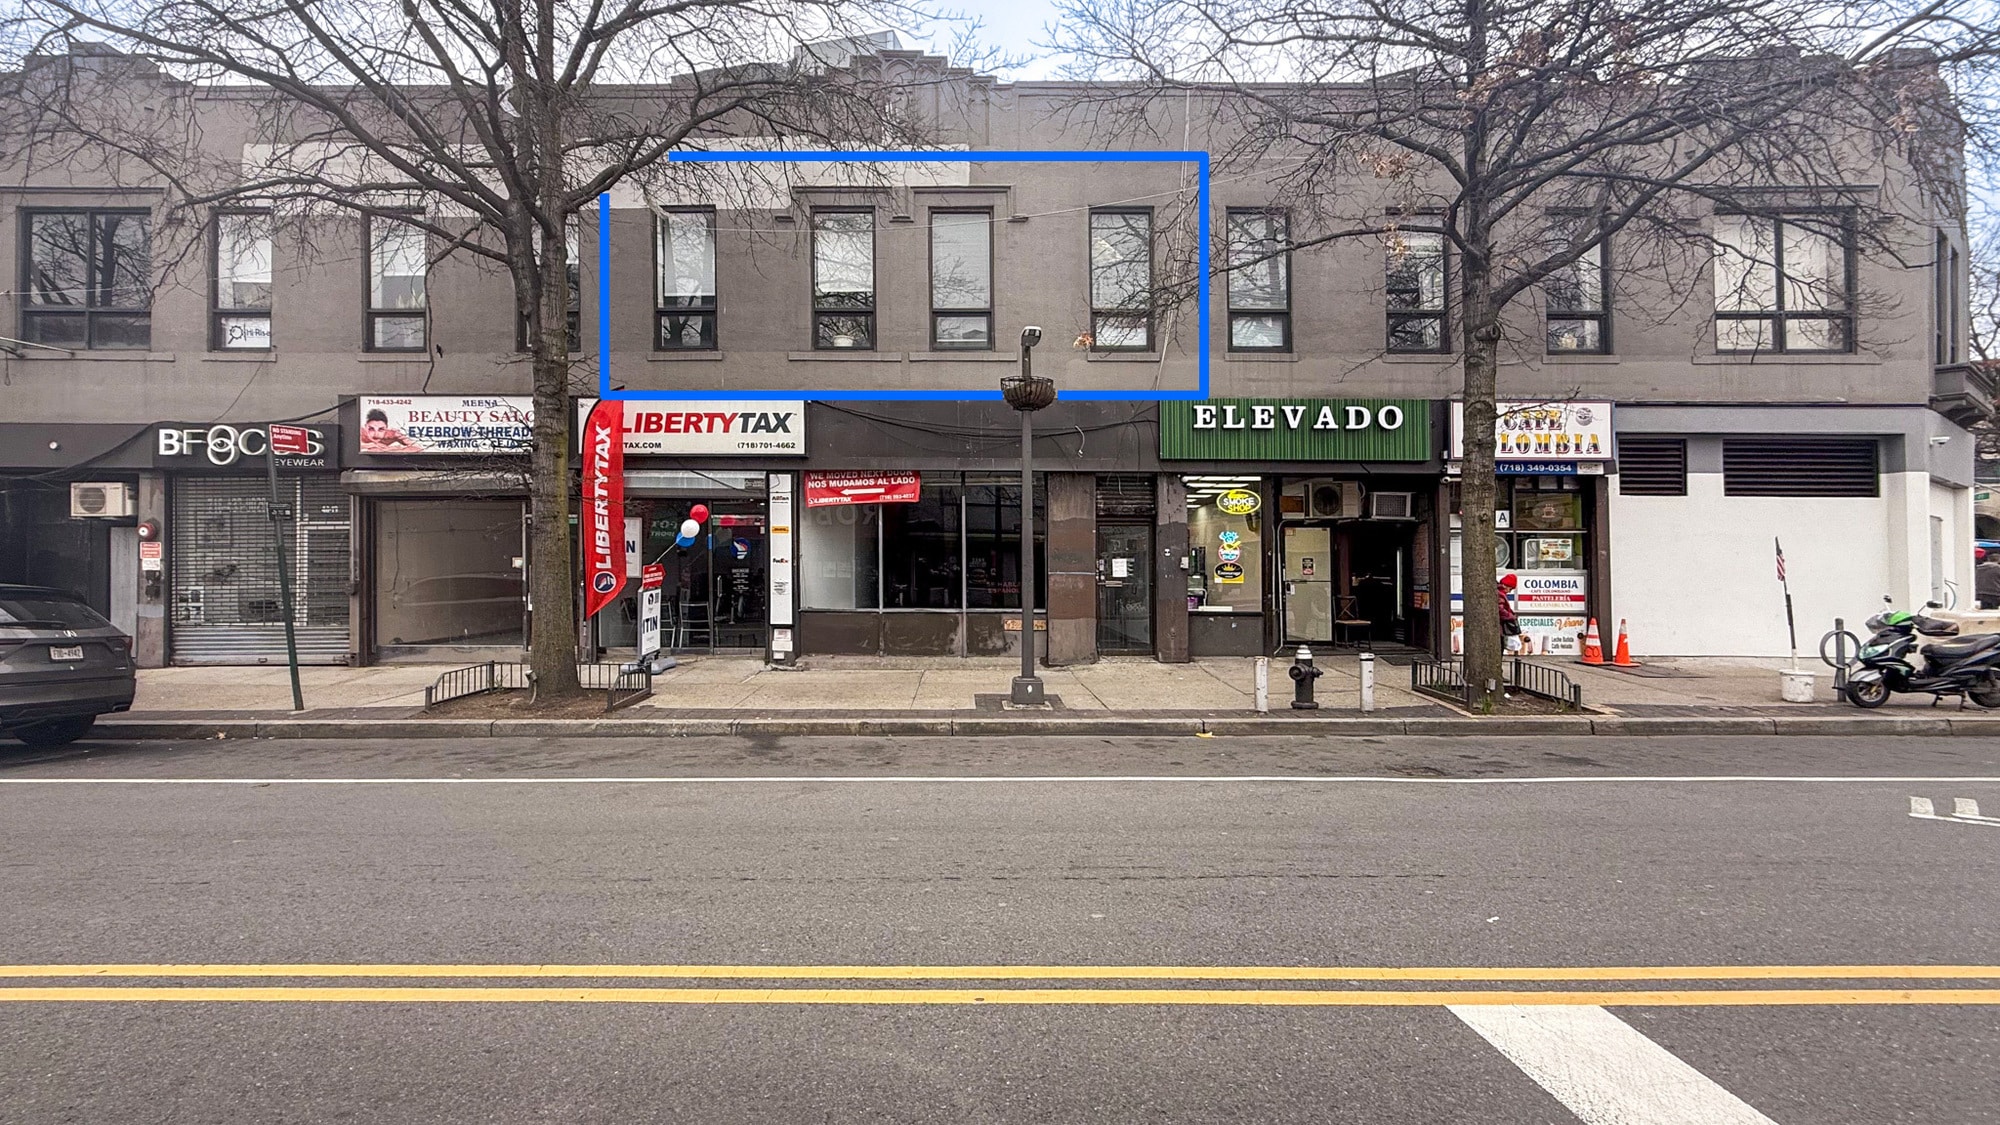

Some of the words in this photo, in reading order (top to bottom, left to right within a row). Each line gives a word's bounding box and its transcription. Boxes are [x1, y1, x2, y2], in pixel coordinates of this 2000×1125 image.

[461, 399, 498, 408] MEENA
[408, 410, 486, 423] BEAUTY
[489, 410, 535, 423] SALO
[1193, 405, 1404, 430] ELEVADO
[280, 428, 302, 436] STANDING
[408, 426, 473, 438] EYEBROW
[478, 426, 534, 438] THREAD
[438, 439, 479, 449] WAXING
[1500, 433, 1602, 455] LOMBIA
[275, 458, 325, 467] EYEWEAR
[1500, 463, 1525, 474] (718)
[1527, 463, 1573, 473] 349-0354
[809, 472, 825, 480] WE
[826, 471, 858, 479] MOVED
[860, 470, 885, 478] NEXT
[808, 480, 827, 489] NOS
[829, 478, 875, 488] MUDAMOS
[877, 478, 889, 486] AL
[890, 476, 915, 485] LADO
[594, 425, 611, 569] LIBERTYTAX
[813, 496, 853, 504] LIBERTYTAX
[1223, 497, 1256, 506] SMOKE
[1227, 504, 1251, 512] SHOP
[1497, 512, 1508, 523] A
[1524, 579, 1578, 590] COLOMBIA
[642, 616, 658, 634] ITIN
[1519, 618, 1554, 627] ESPECIALES
